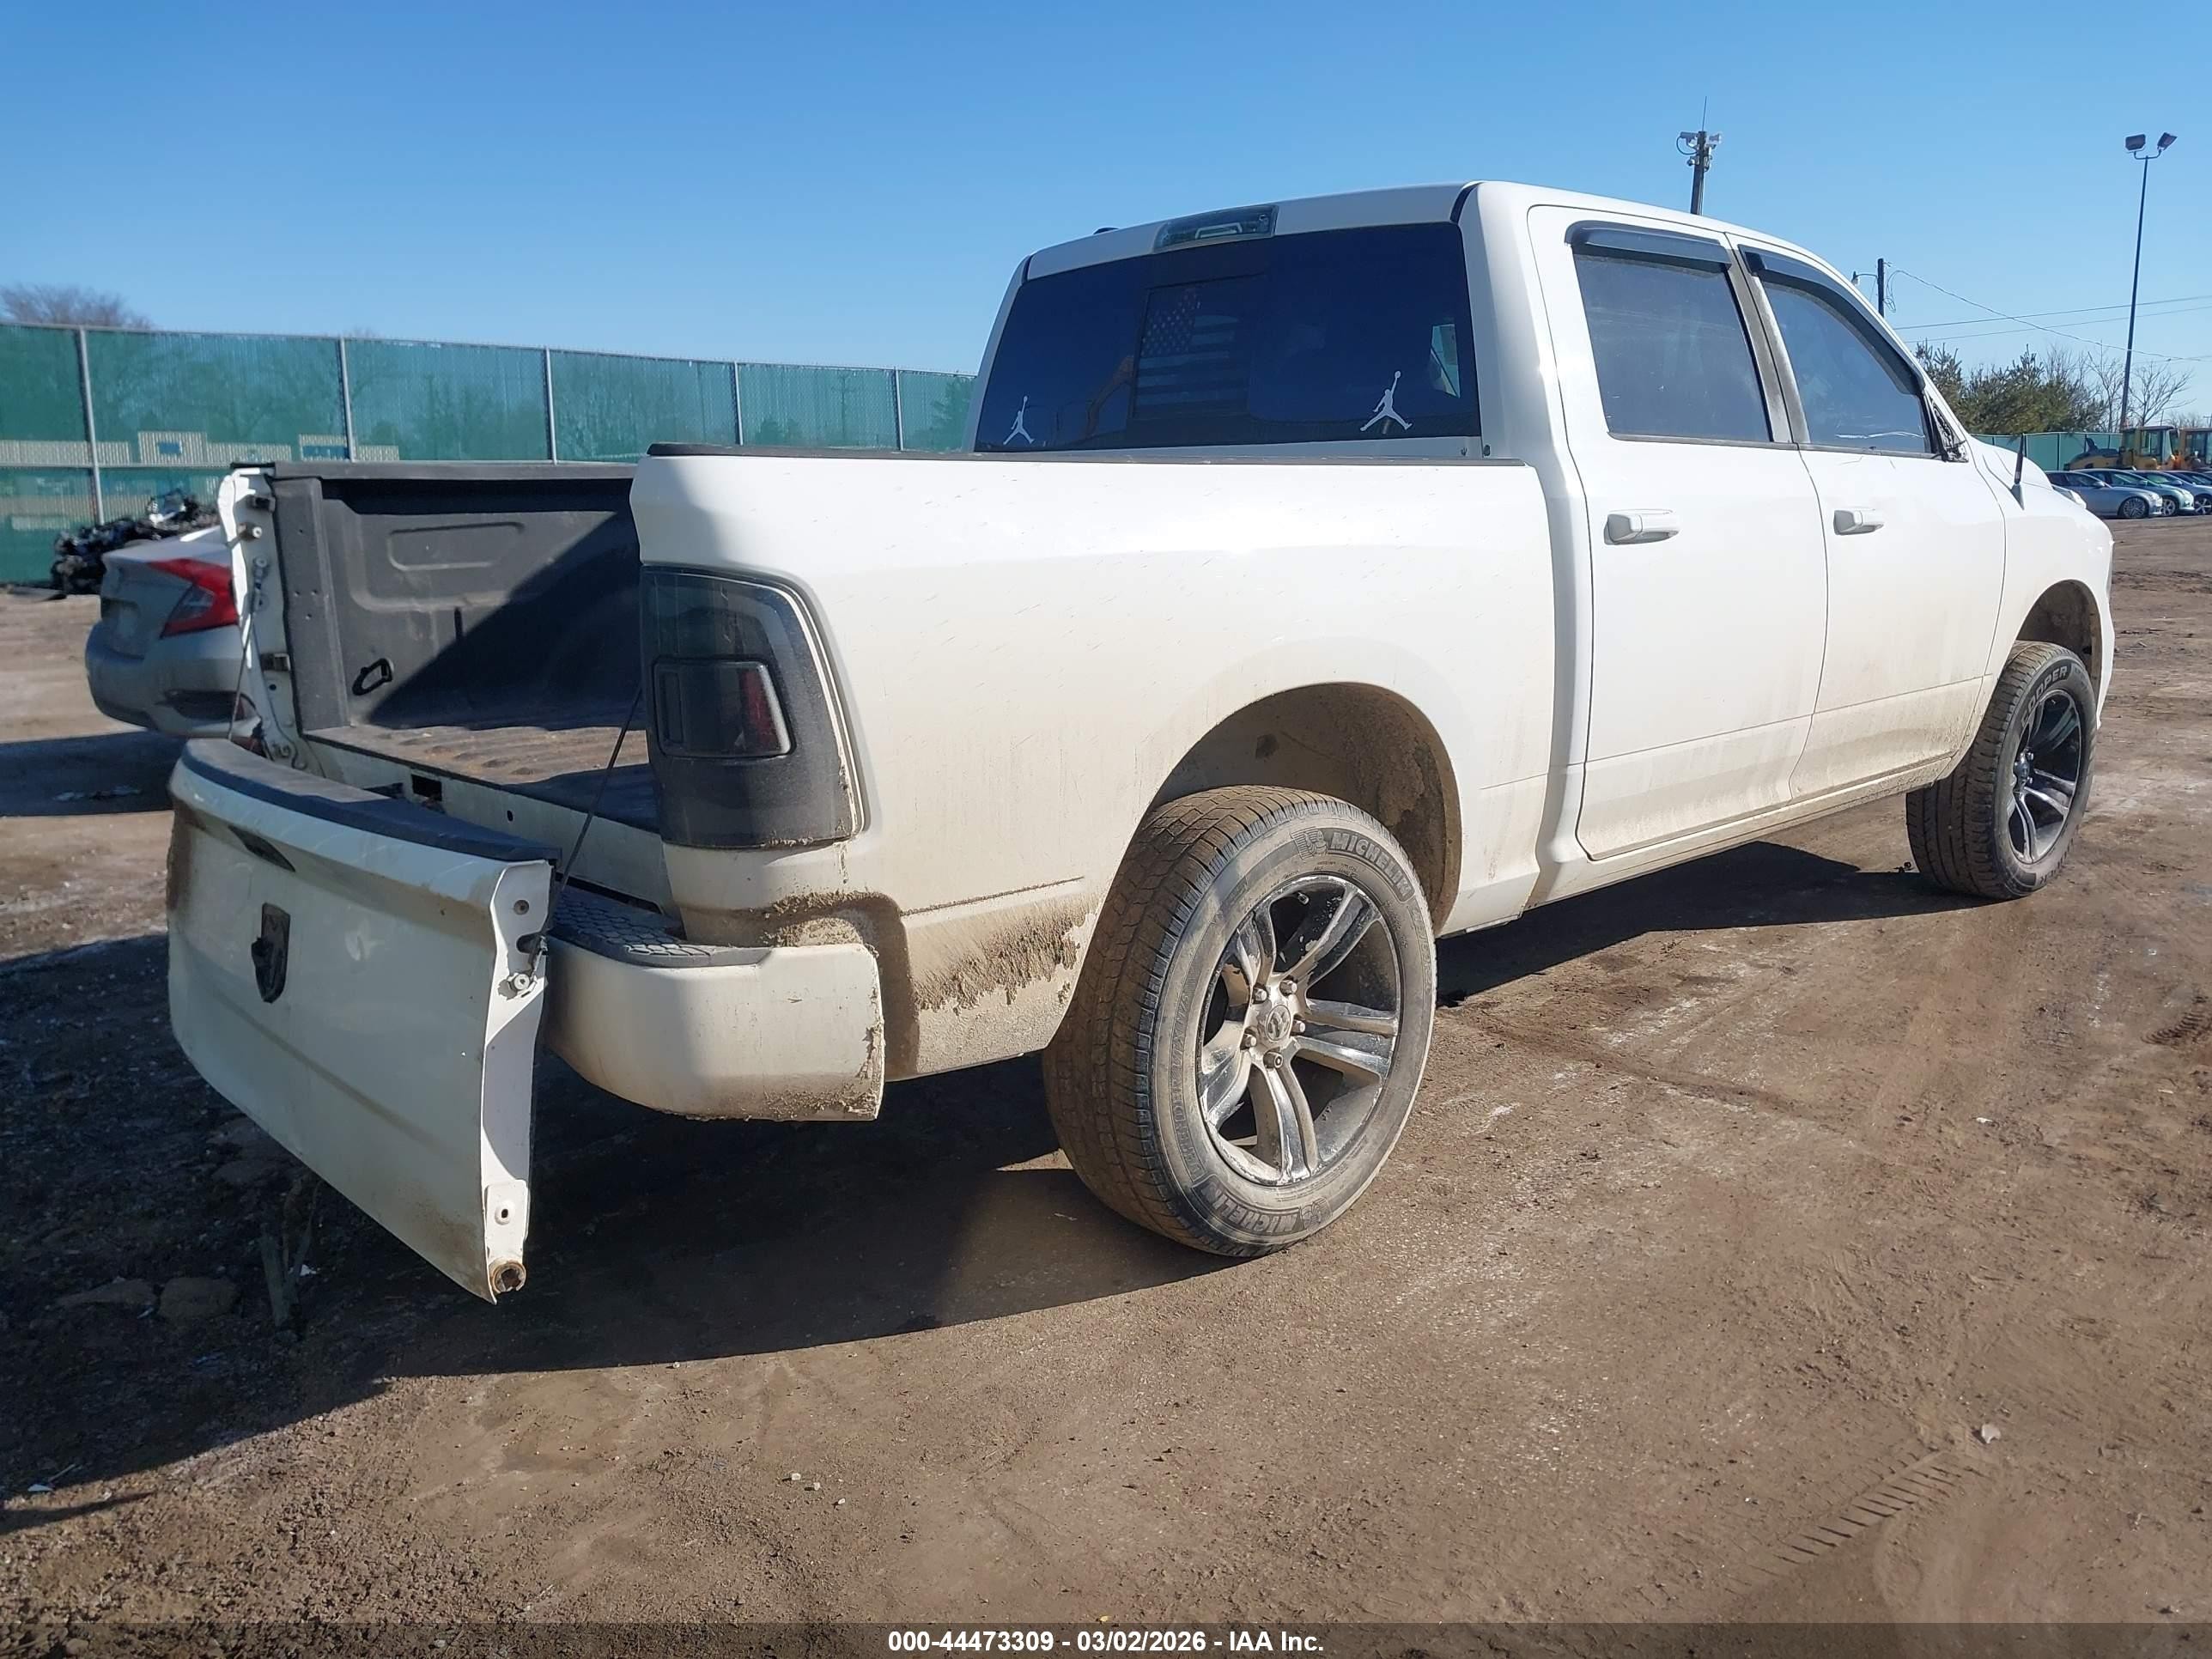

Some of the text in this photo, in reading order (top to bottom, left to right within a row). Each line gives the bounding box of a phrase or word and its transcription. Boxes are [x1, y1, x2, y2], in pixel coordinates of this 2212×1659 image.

[2021, 665, 2068, 728] COOPER
[1330, 831, 1412, 897] MICHELIN
[1202, 1181, 1297, 1233] MICHELIN
